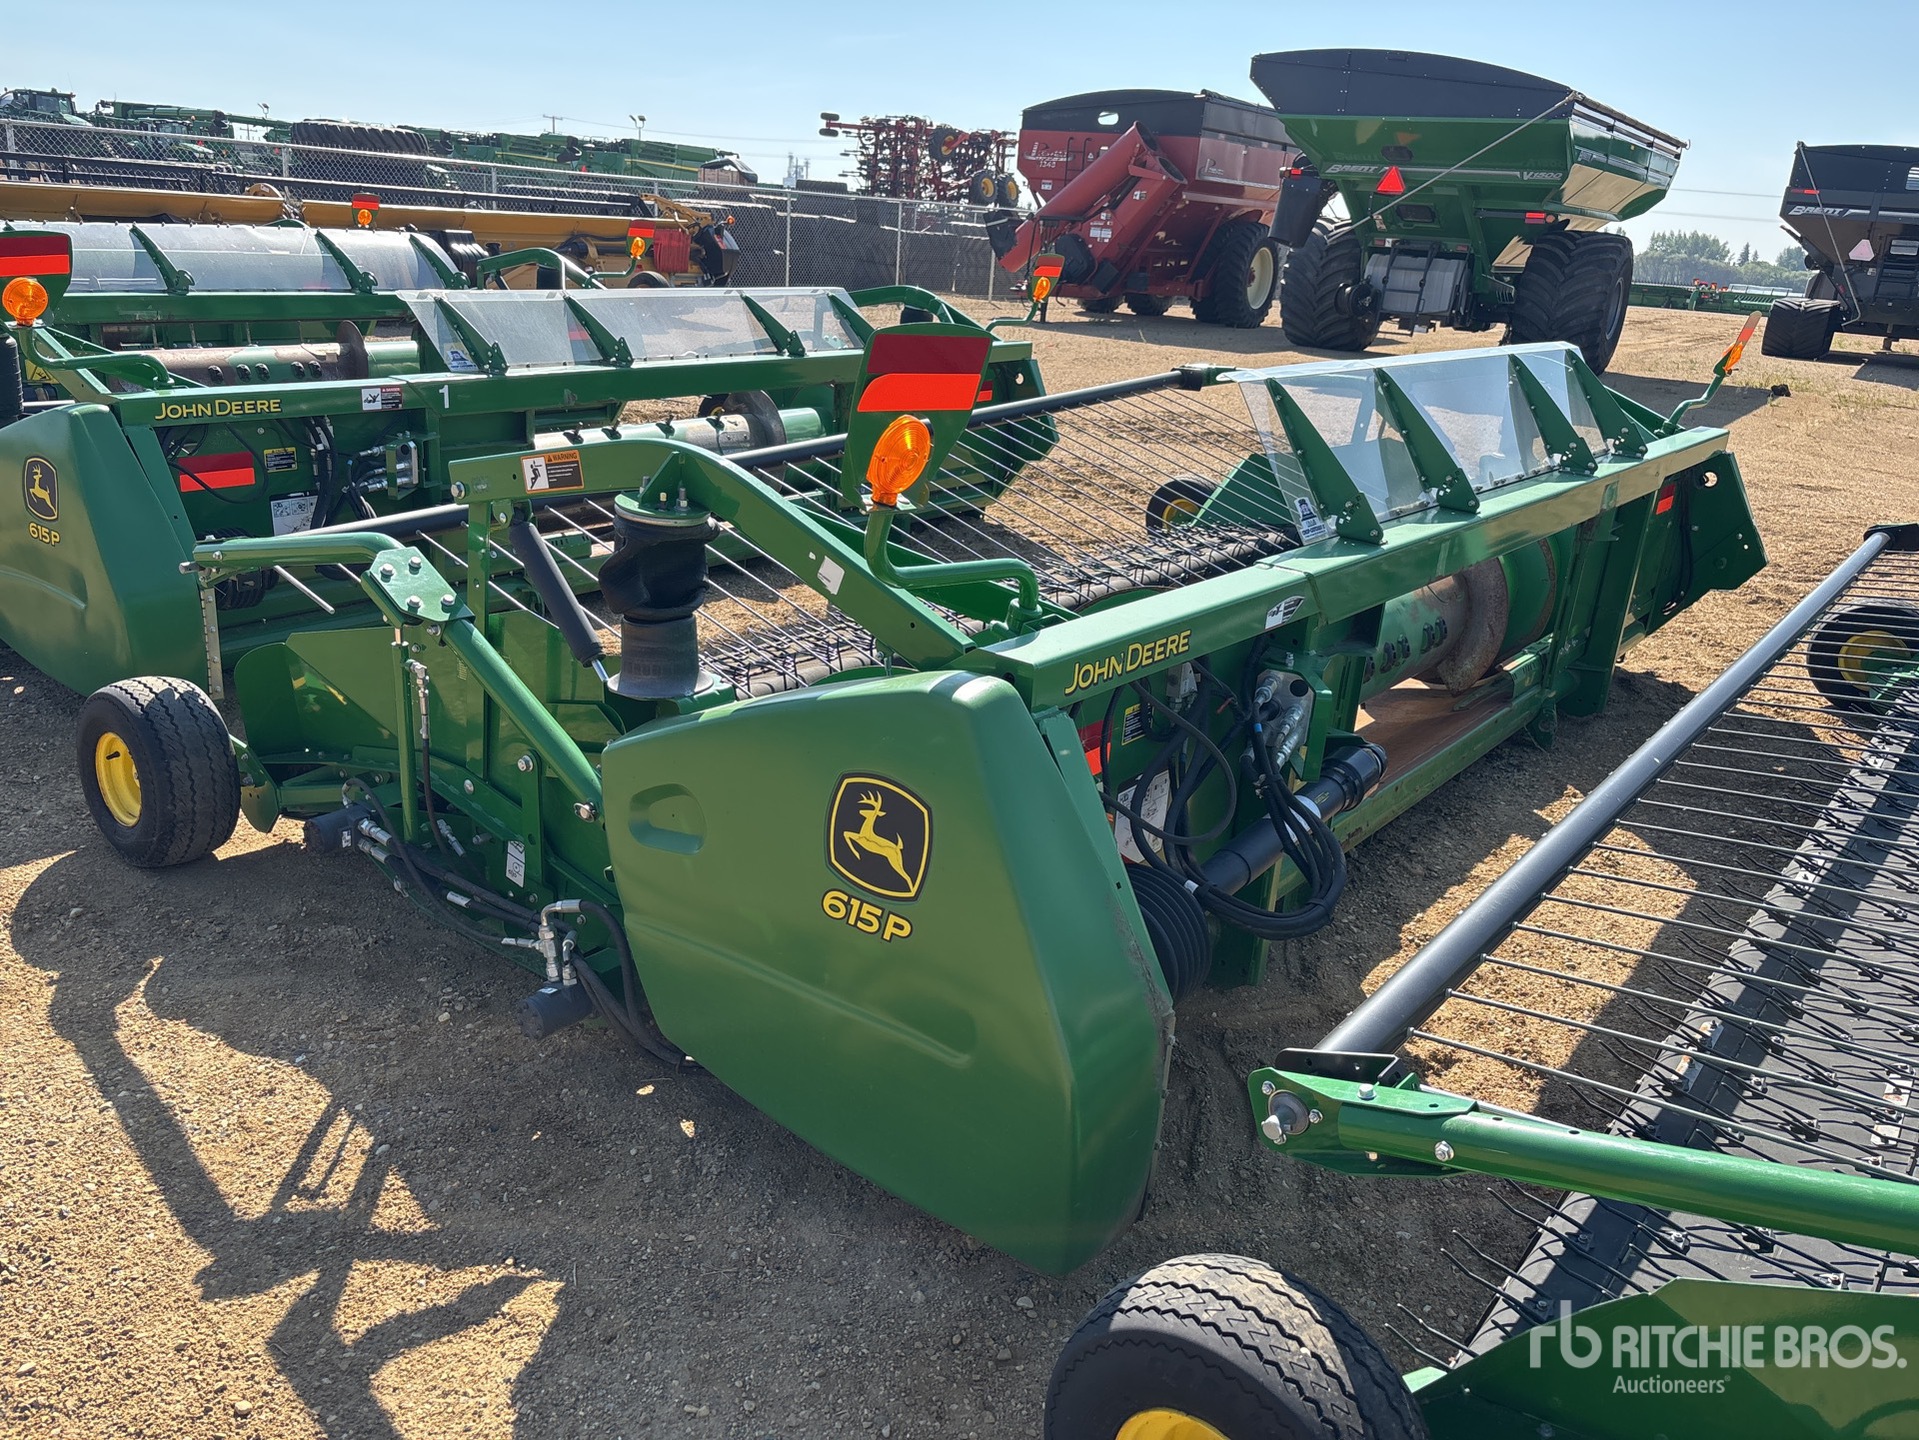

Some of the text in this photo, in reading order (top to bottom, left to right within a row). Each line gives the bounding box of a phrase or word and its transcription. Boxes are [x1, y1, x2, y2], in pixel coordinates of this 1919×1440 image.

[1788, 205, 1844, 216] BRENT
[439, 384, 450, 409] 1
[154, 399, 282, 420] JOHN DEERE
[553, 452, 578, 461] WARNING
[28, 521, 61, 546] 615P
[1064, 629, 1192, 696] JOHN DEERE
[821, 888, 913, 943] 615P
